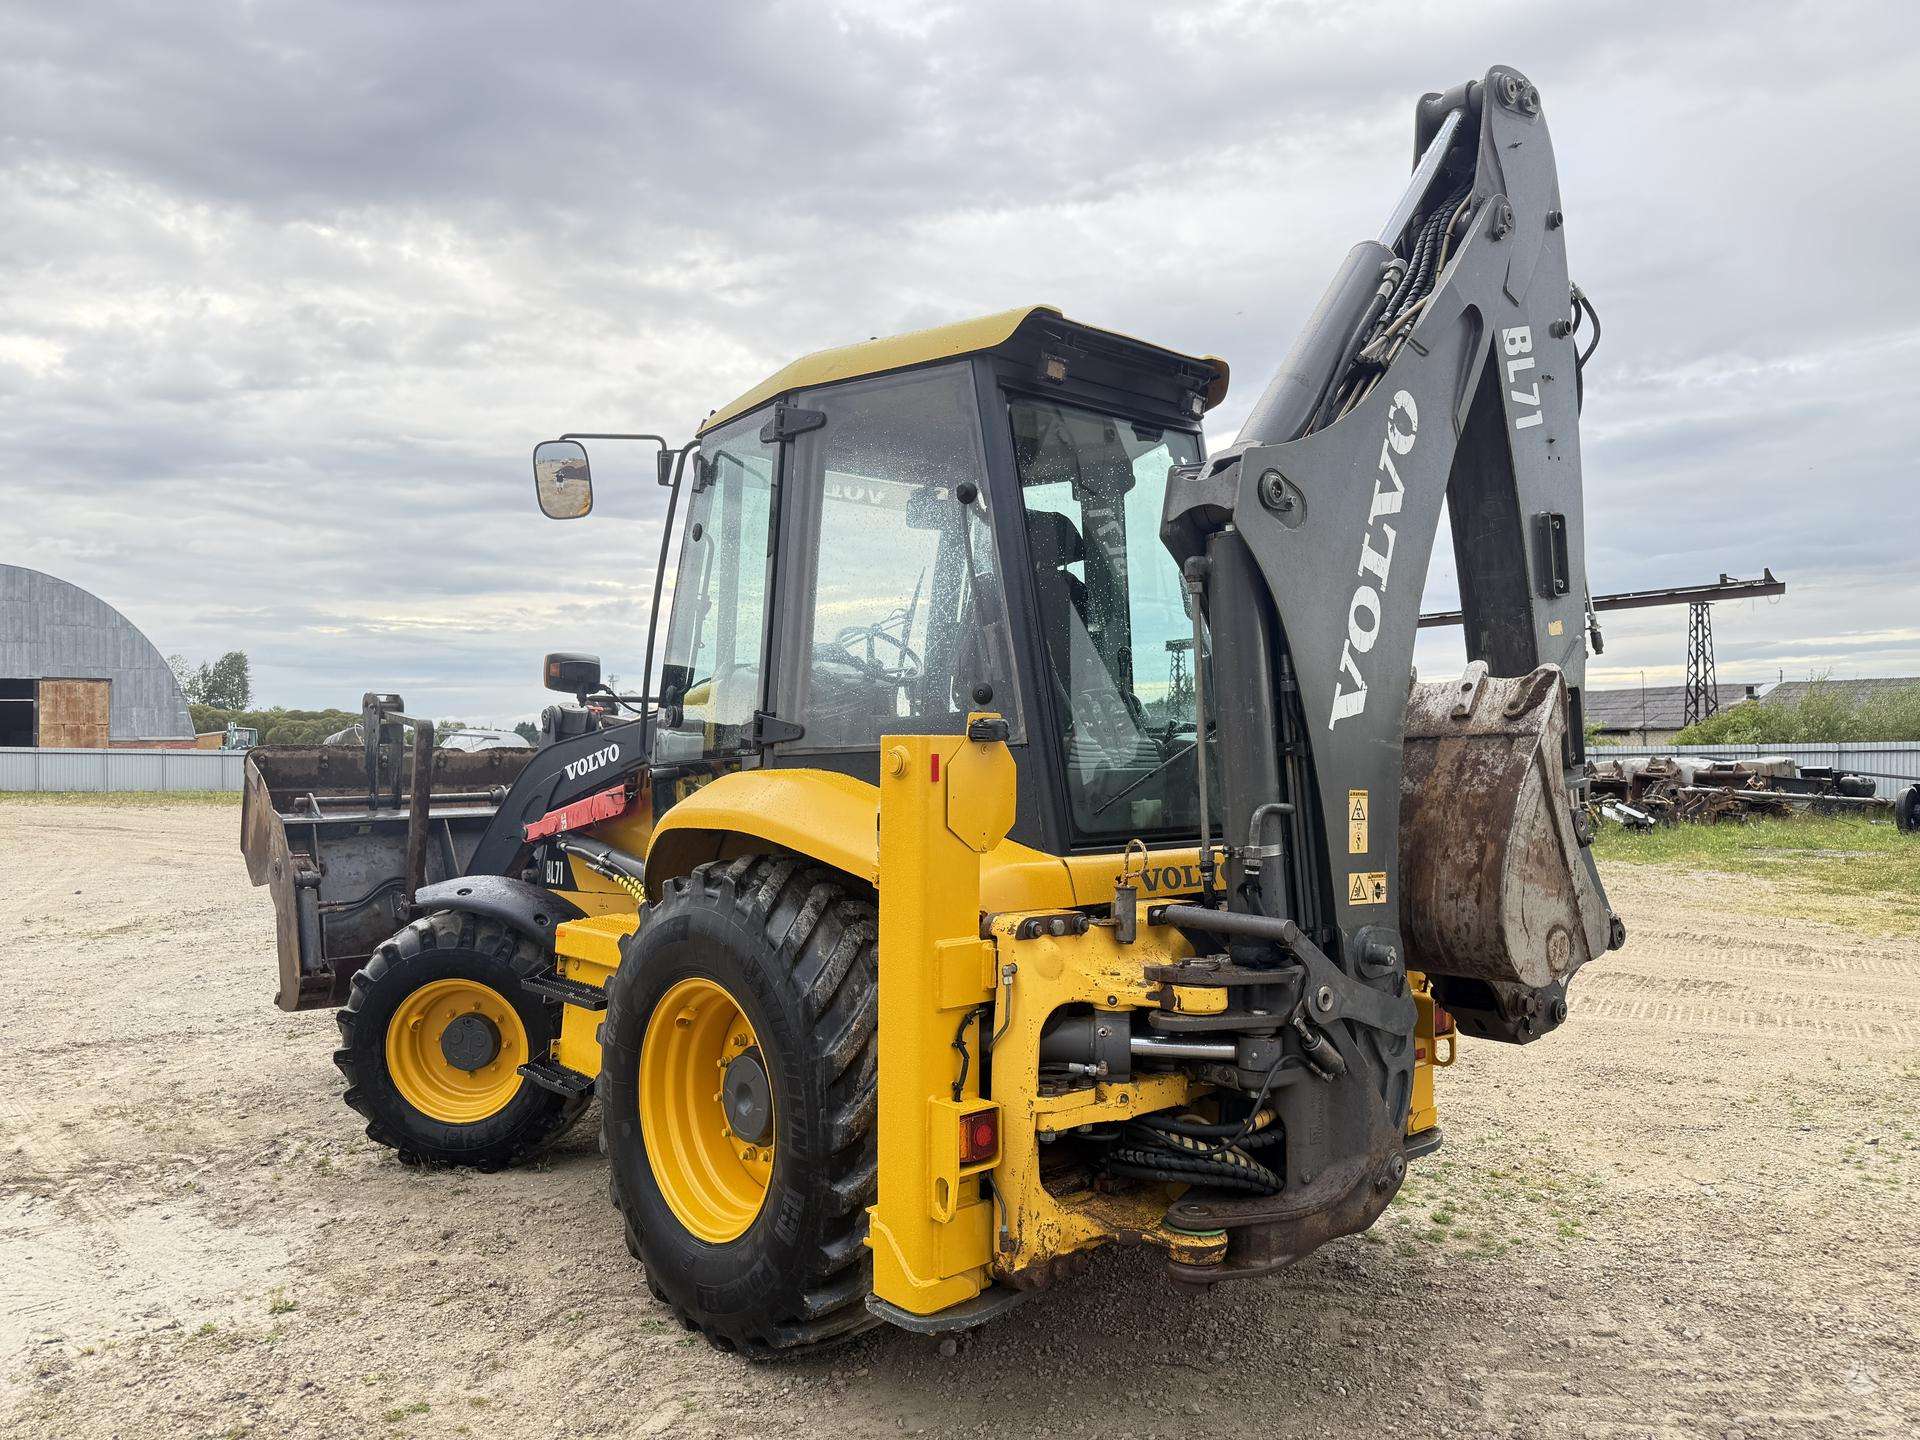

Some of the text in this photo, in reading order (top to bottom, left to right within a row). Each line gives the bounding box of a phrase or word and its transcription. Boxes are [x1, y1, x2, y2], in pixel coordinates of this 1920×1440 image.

[1501, 325, 1543, 430] BL71
[1328, 389, 1419, 731] VOLVO
[564, 743, 620, 781] VOLVO
[546, 860, 564, 885] BL71
[1135, 863, 1233, 891] VOL
